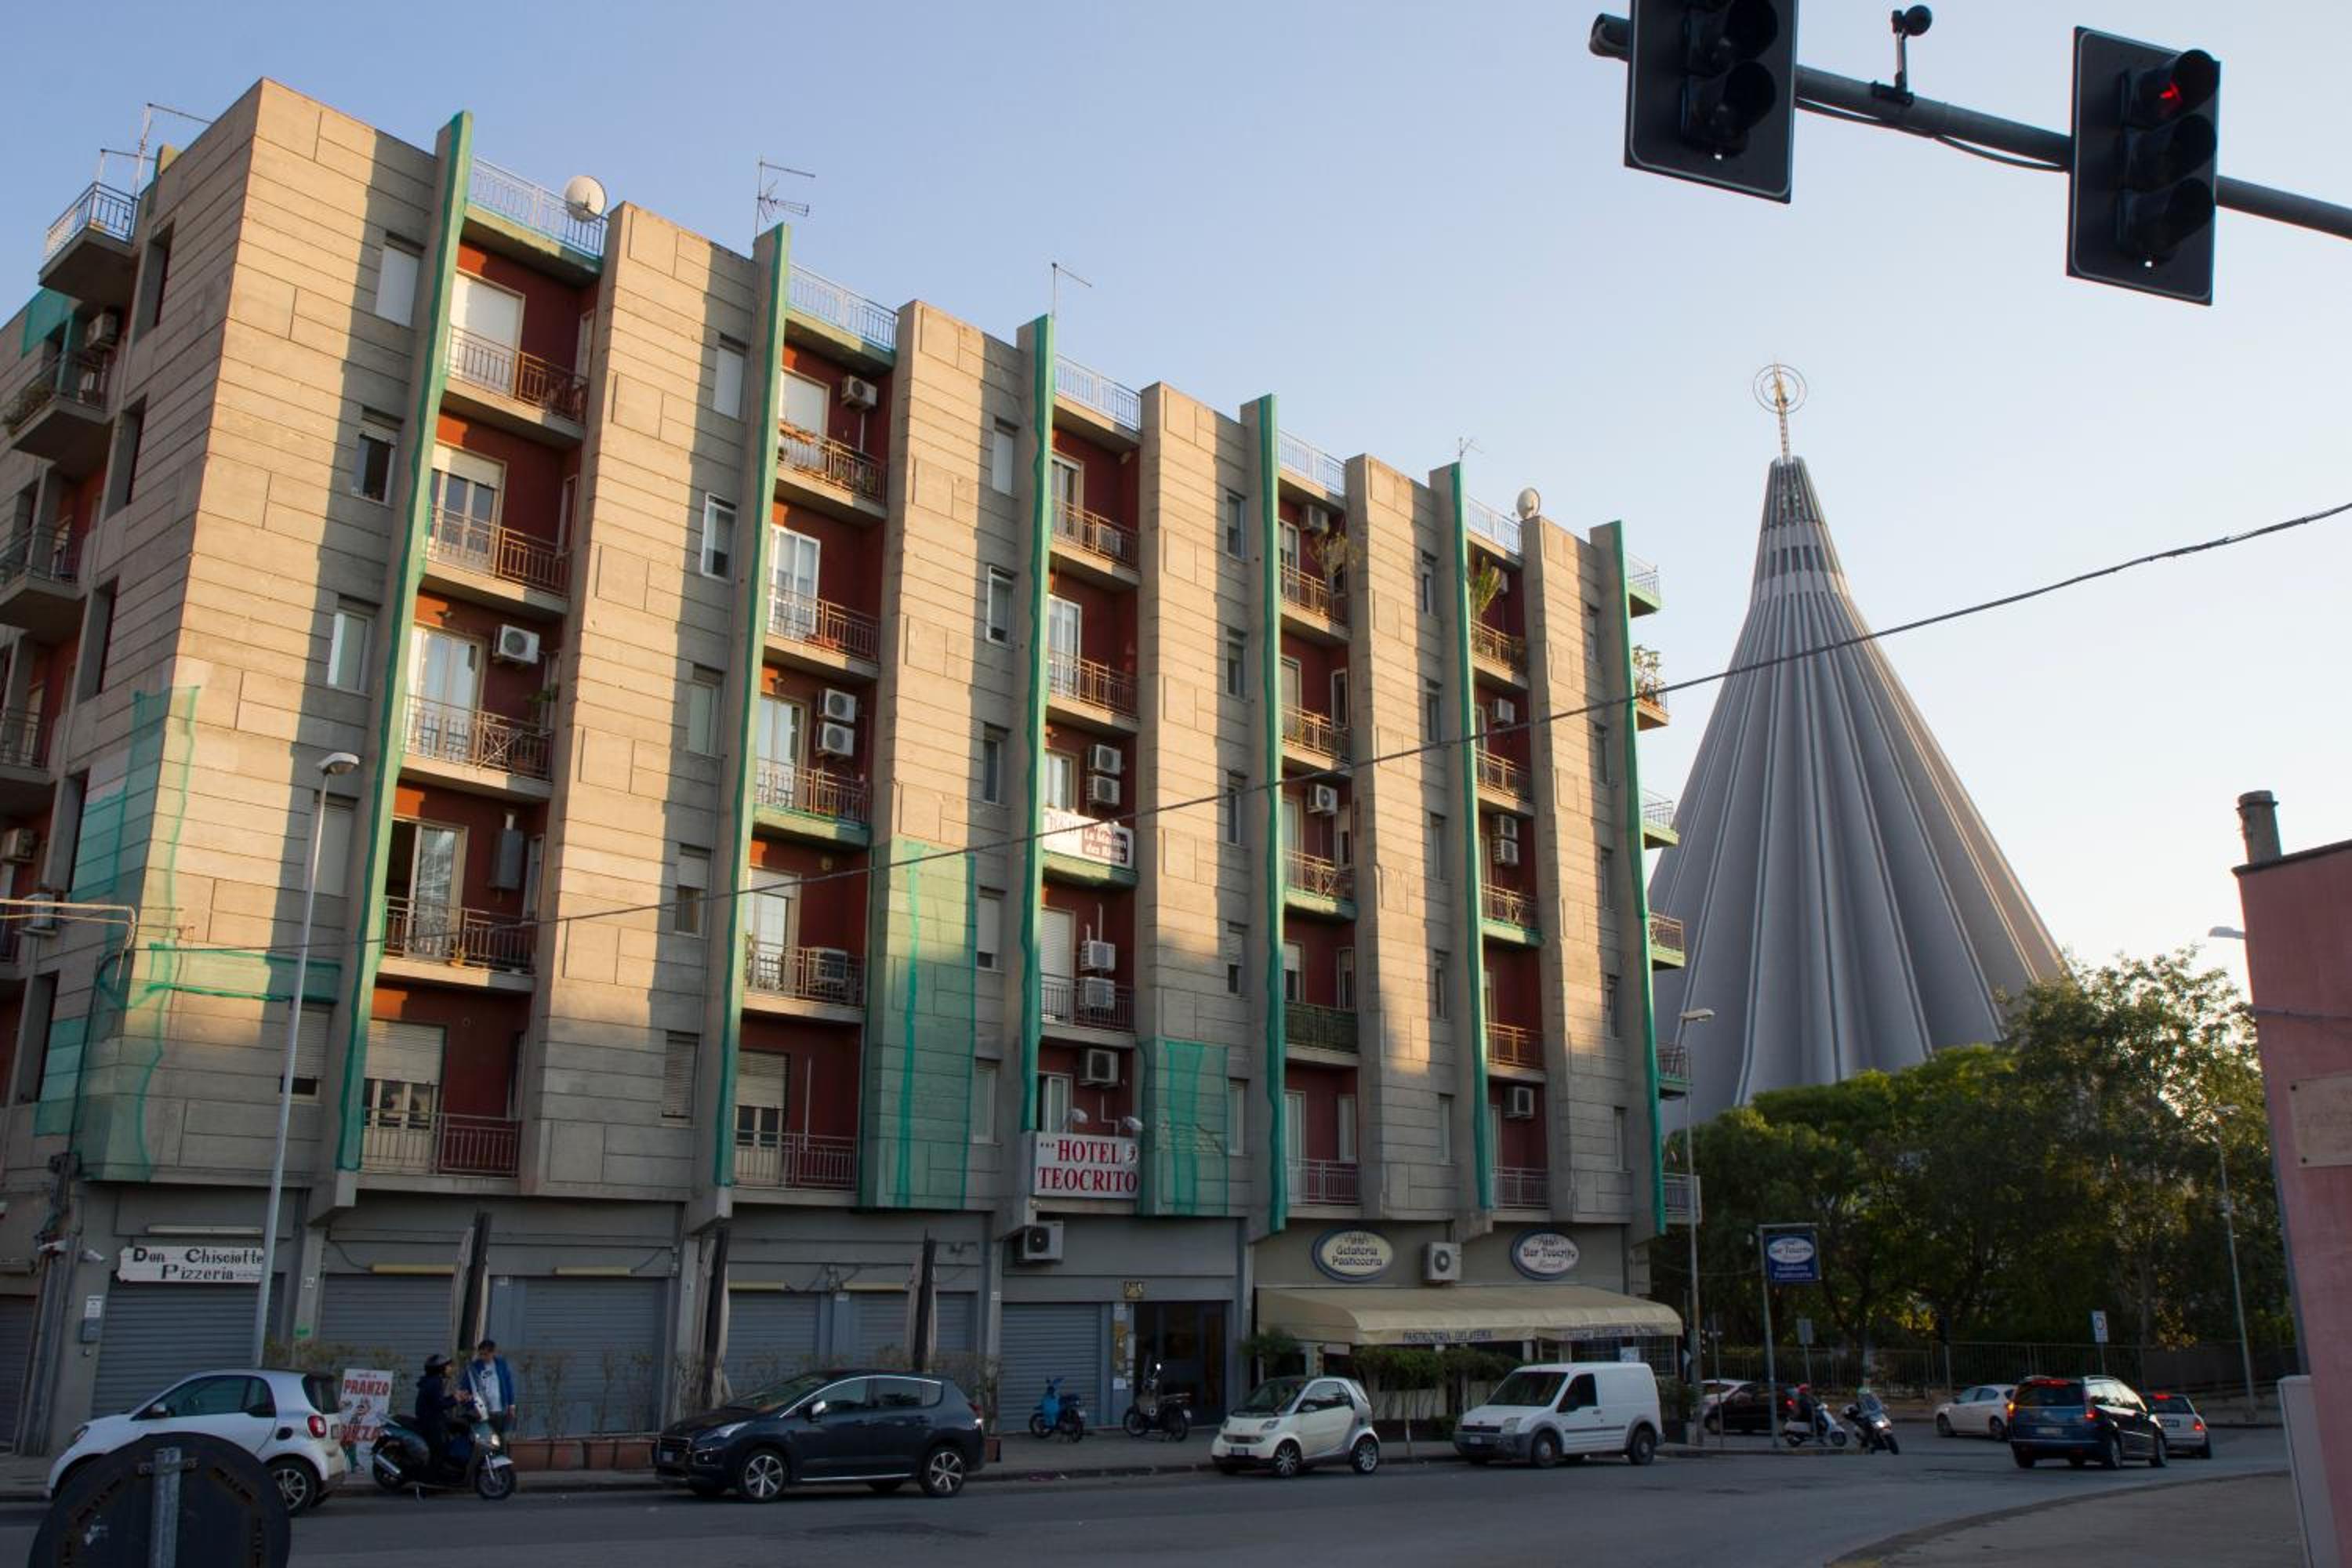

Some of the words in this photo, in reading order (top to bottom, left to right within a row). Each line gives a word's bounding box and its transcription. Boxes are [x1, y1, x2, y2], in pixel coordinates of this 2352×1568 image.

[1058, 1139, 1121, 1164] HOTEL
[1038, 1167, 1138, 1192] TEOCRITO
[132, 1247, 165, 1263] Don
[185, 1248, 263, 1264] Chisciotte
[162, 1265, 234, 1279] Pizzeria
[343, 1380, 390, 1396] PRANZO
